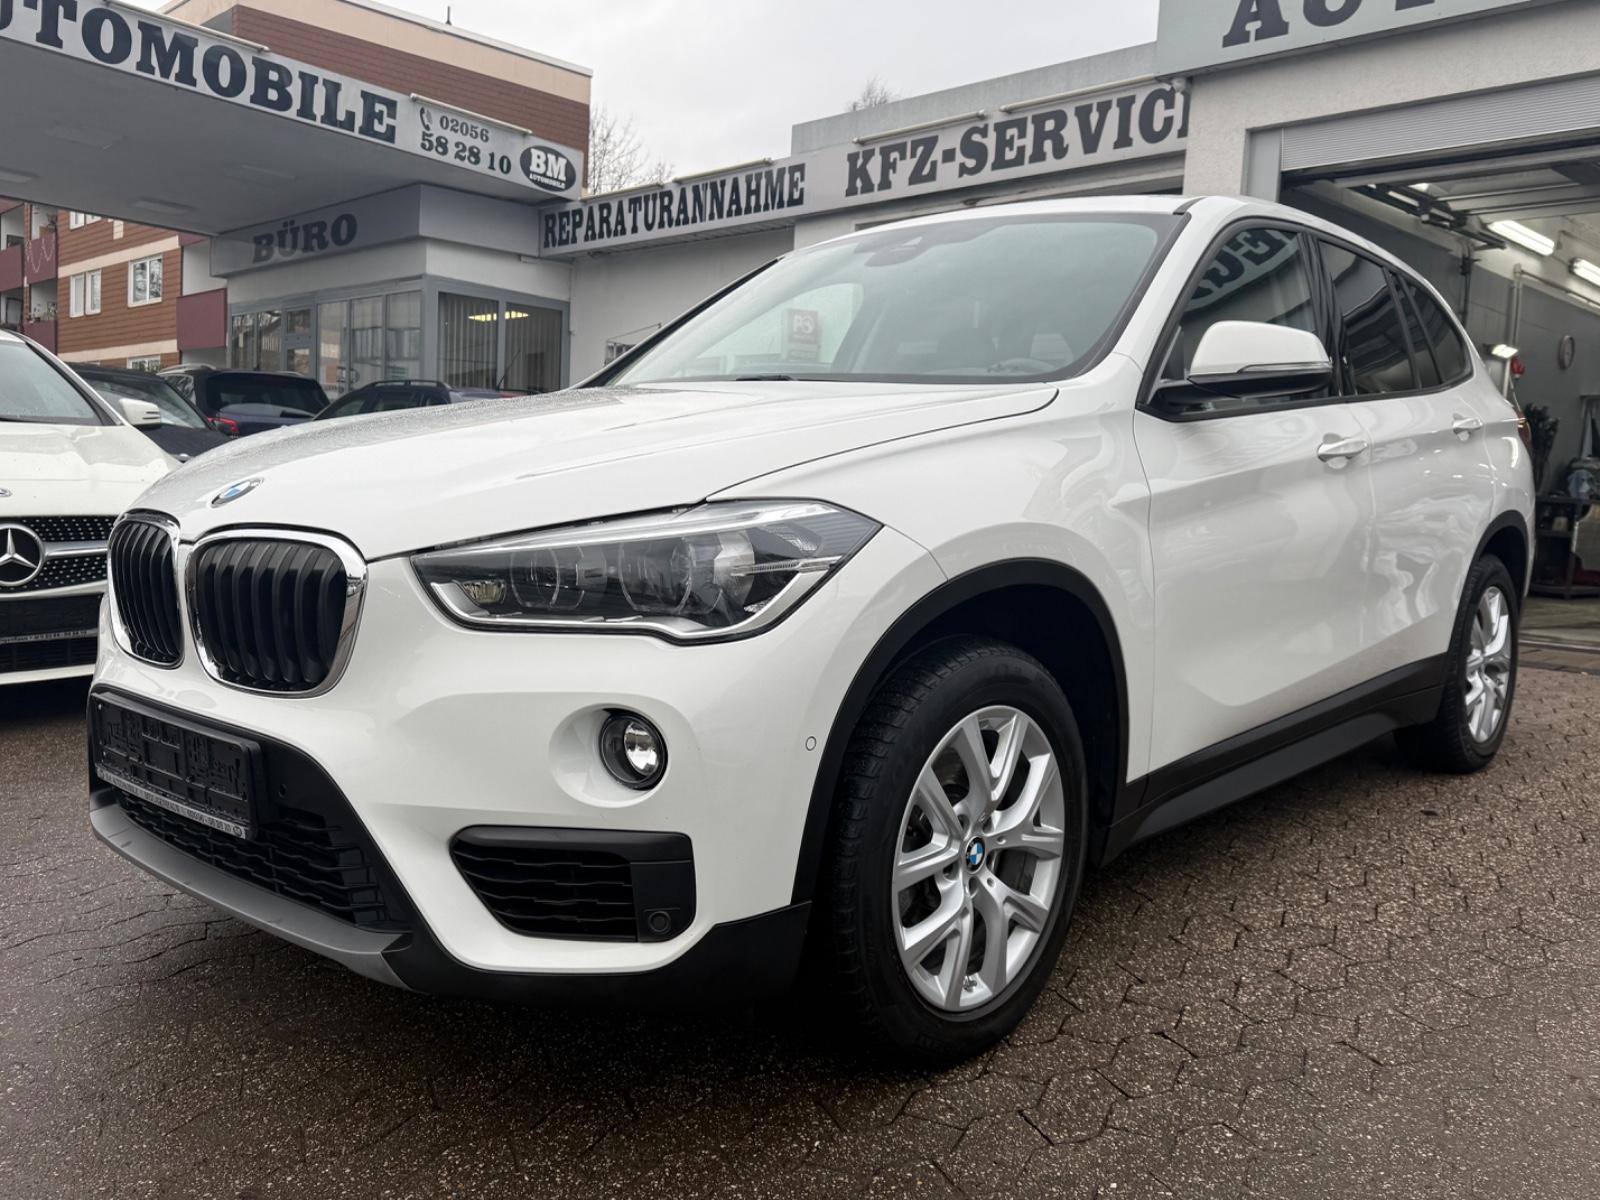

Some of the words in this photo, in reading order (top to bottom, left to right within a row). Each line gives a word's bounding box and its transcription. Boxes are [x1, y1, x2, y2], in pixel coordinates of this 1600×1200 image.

[0, 0, 397, 144] TOMOBILE
[420, 131, 449, 156] 58
[454, 142, 481, 165] 28
[487, 152, 512, 174] 10
[439, 115, 490, 143] 02056
[529, 147, 568, 182] BM
[543, 162, 806, 249] REPARATURANNAHME
[251, 213, 358, 264] BÜRO
